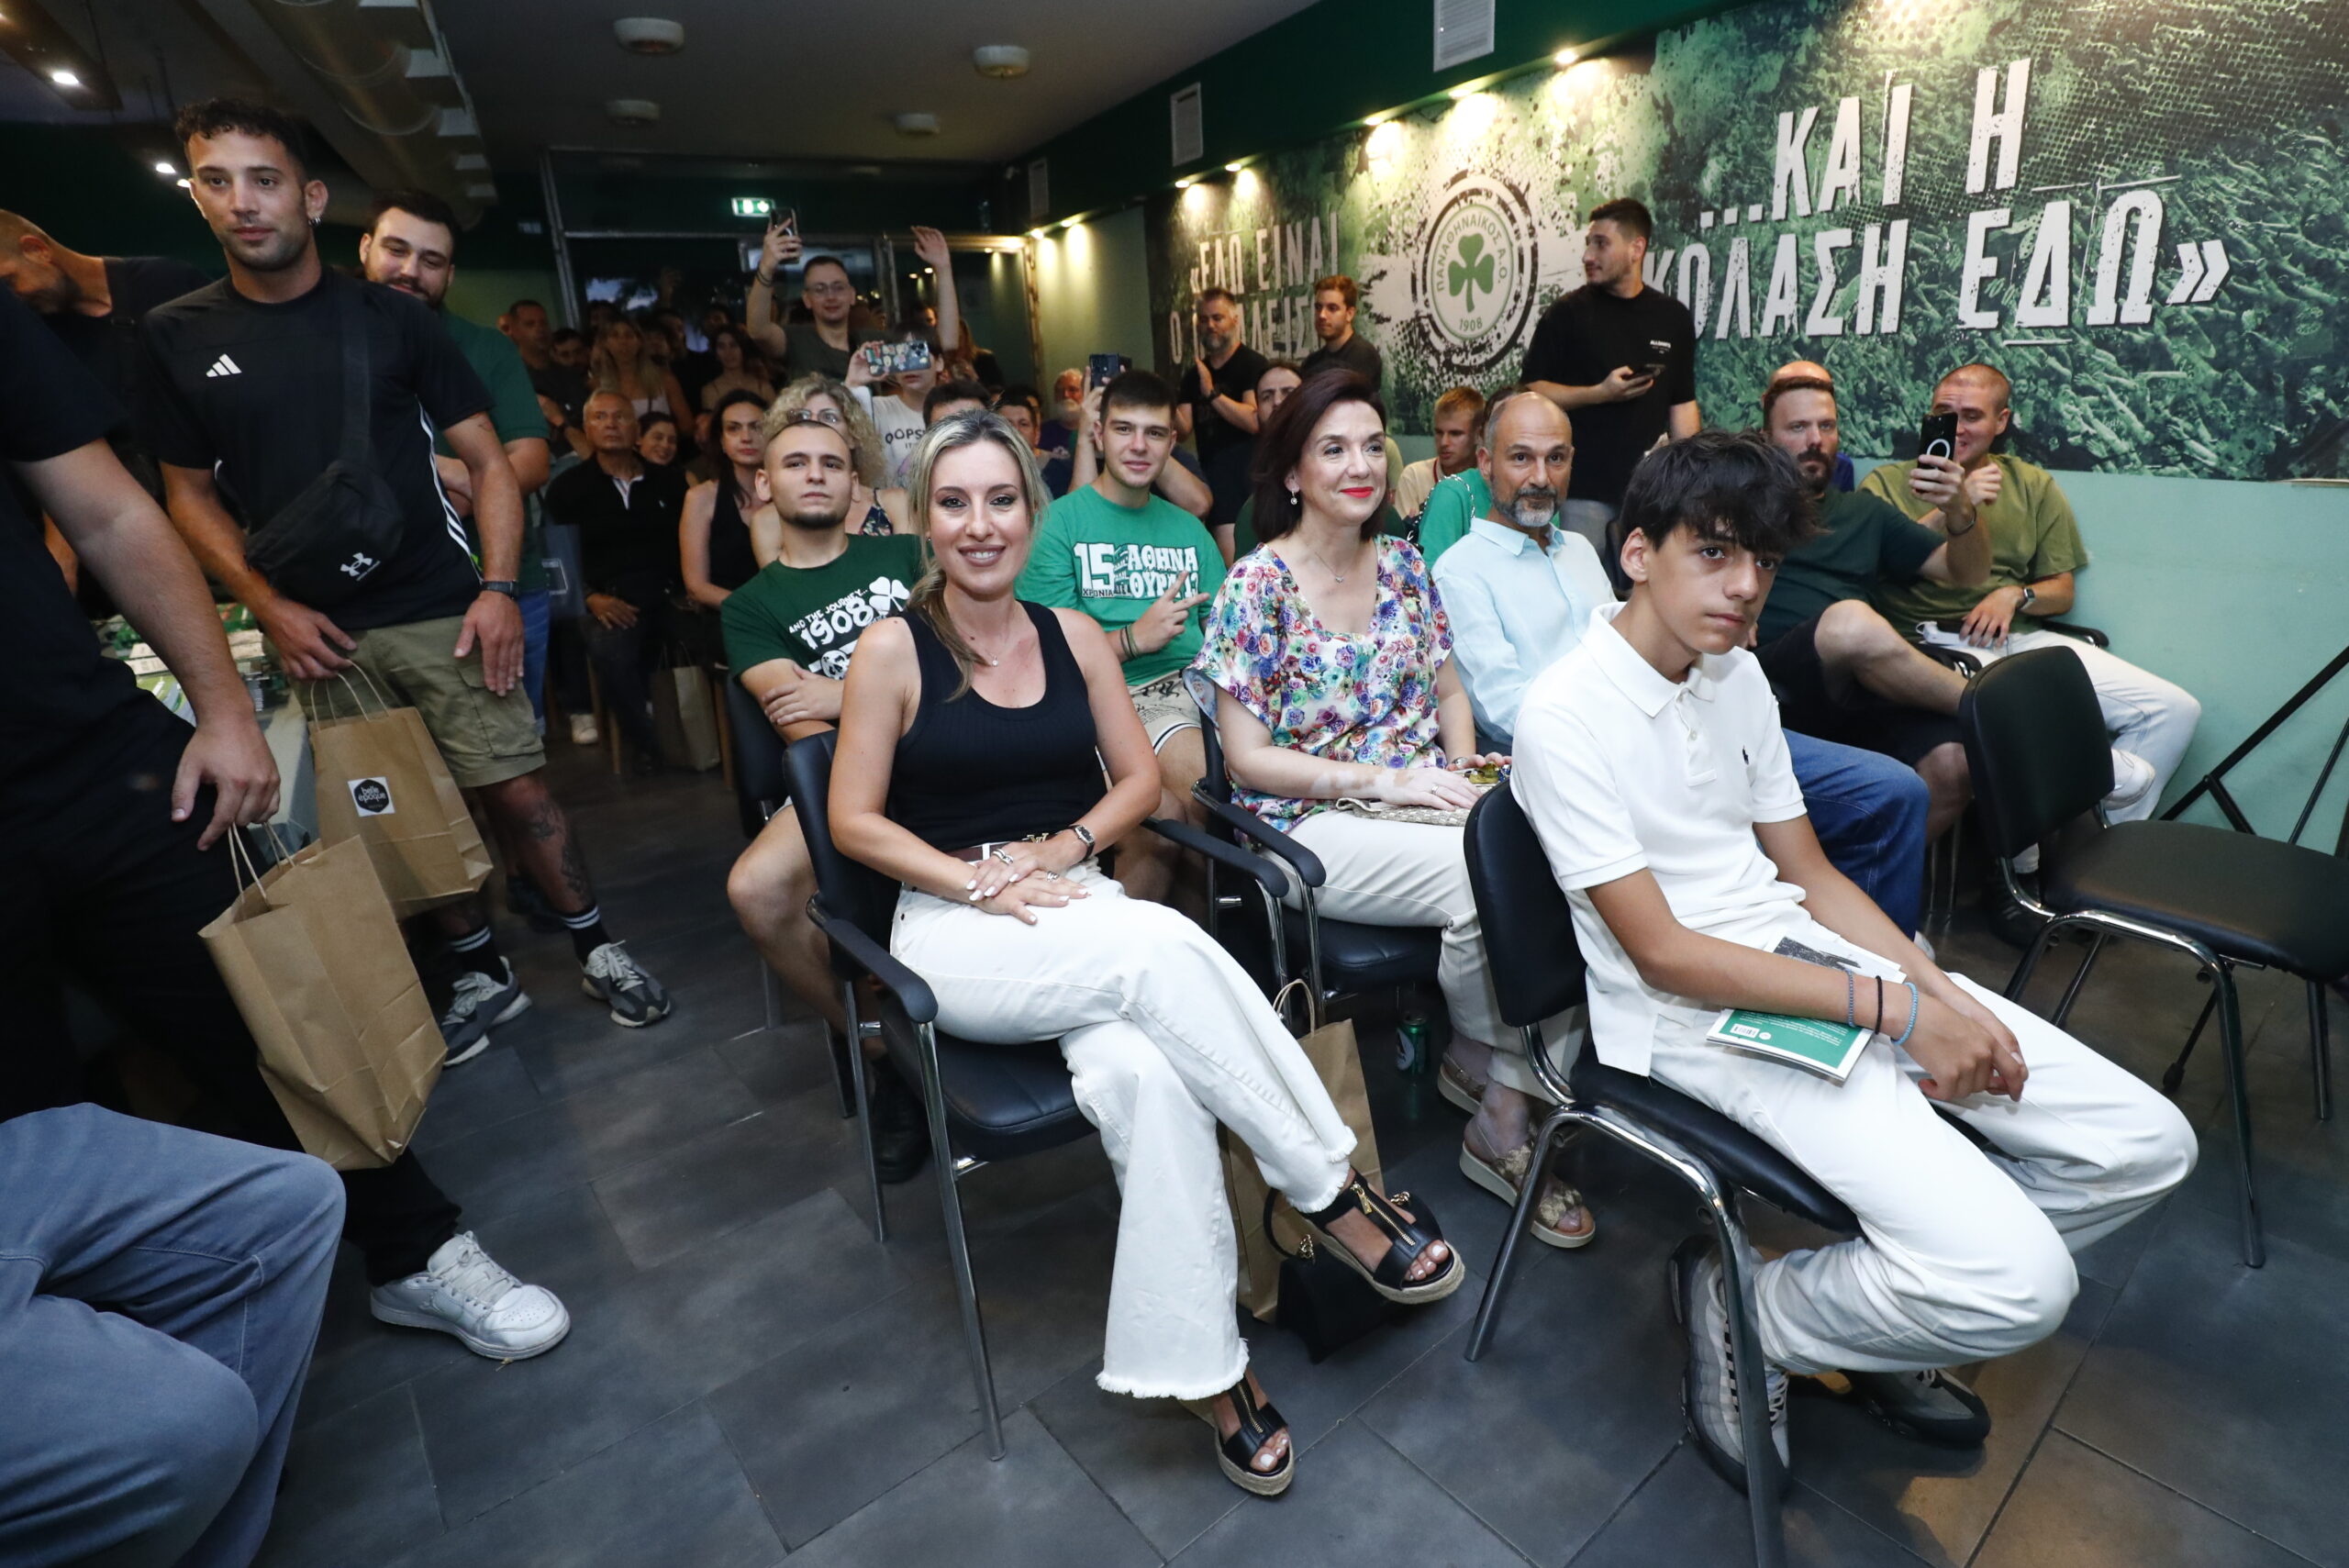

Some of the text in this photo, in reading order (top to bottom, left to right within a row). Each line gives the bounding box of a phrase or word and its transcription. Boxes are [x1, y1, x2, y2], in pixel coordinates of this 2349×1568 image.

[1965, 57, 2032, 195] Η
[1256, 212, 1339, 291] ΕΙΝΑΙ
[1955, 189, 2231, 329] ΕΔΩ»
[1170, 310, 1183, 365] Ο
[1459, 317, 1483, 332] 1908
[1074, 543, 1115, 591] 15
[1128, 544, 1198, 572] ΑΘΗΝΑ
[1082, 588, 1114, 597] ΧΡΟΝΙΑ
[789, 619, 806, 633] AND
[805, 609, 824, 624] THE
[800, 597, 874, 650] 1908
